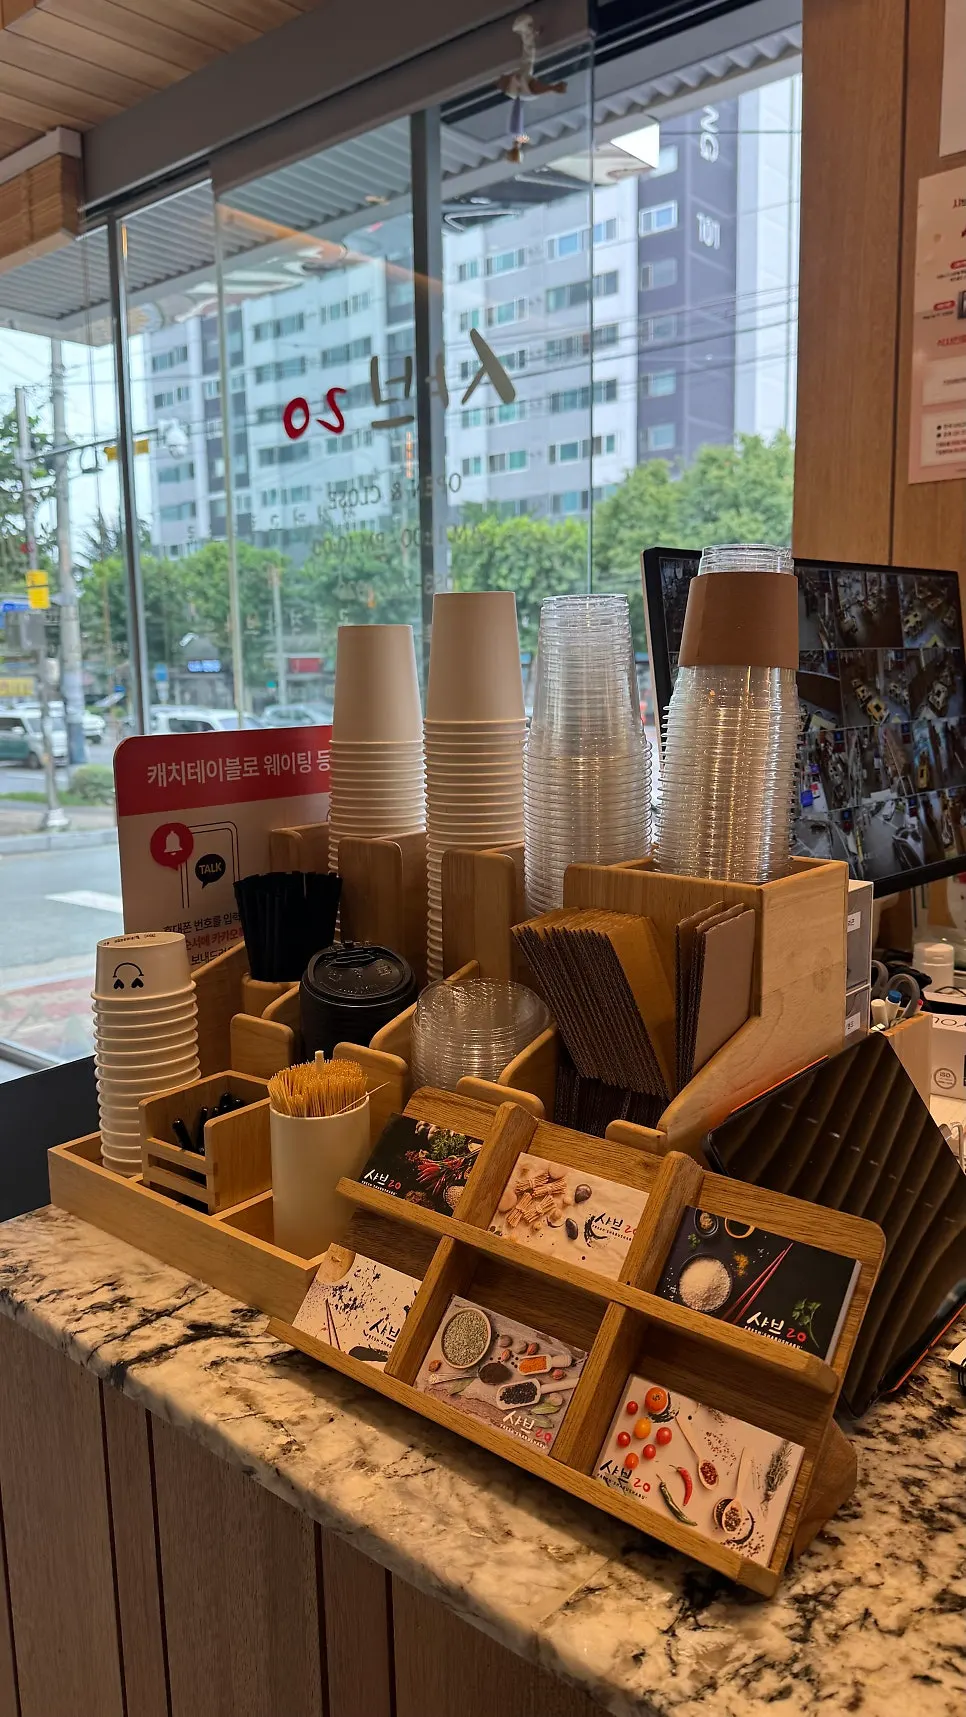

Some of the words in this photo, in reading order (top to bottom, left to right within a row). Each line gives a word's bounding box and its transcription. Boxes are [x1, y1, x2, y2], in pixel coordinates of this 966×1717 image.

[147, 757, 260, 788] 캐치테이블로
[263, 750, 312, 777] 웨이팅
[199, 861, 222, 875] TALK
[194, 916, 221, 931] 번호를
[363, 1168, 390, 1186] 샤브
[387, 1179, 402, 1190] 20
[594, 1212, 624, 1231] 샤브
[746, 1311, 785, 1335] 샤브
[786, 1327, 807, 1343] 20
[502, 1410, 535, 1434] 샤브
[535, 1427, 552, 1442] 20
[600, 1459, 633, 1484] 샤브
[633, 1477, 651, 1492] 20
